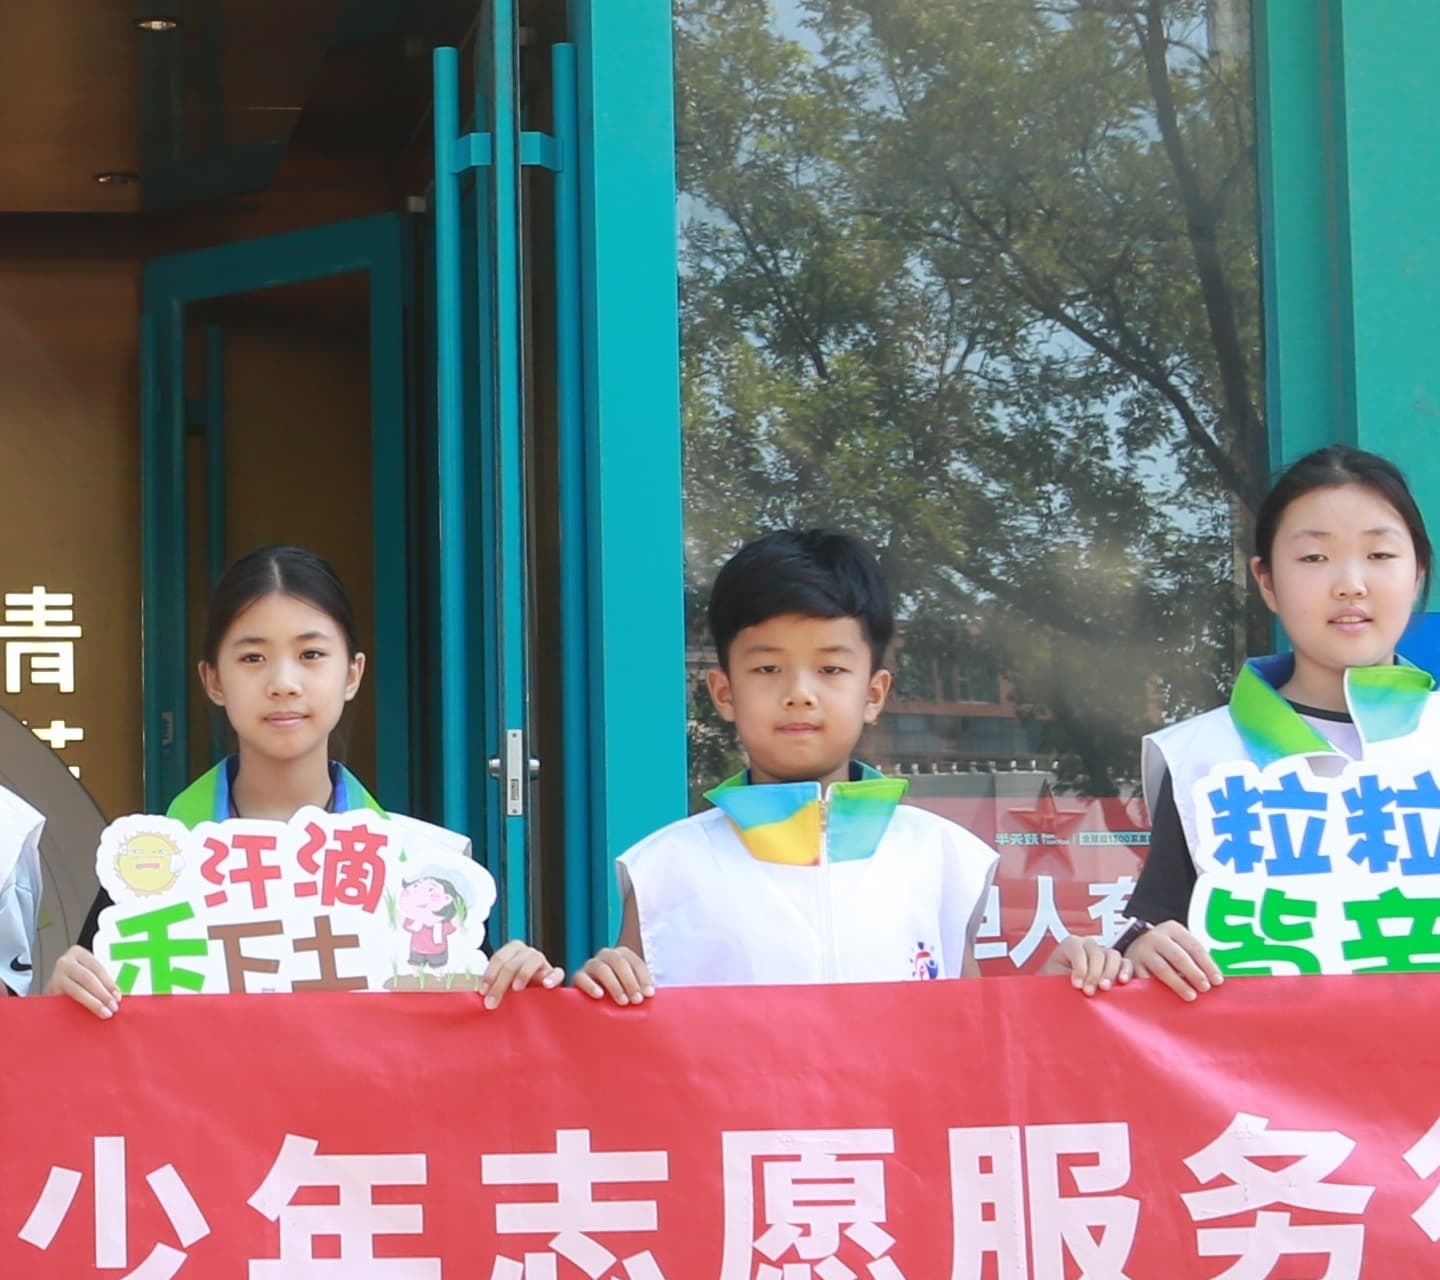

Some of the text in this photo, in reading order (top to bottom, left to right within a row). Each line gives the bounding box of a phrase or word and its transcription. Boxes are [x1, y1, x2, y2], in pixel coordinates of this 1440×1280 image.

[199, 821, 389, 915] 汗滴
[108, 901, 369, 993] 禾下土
